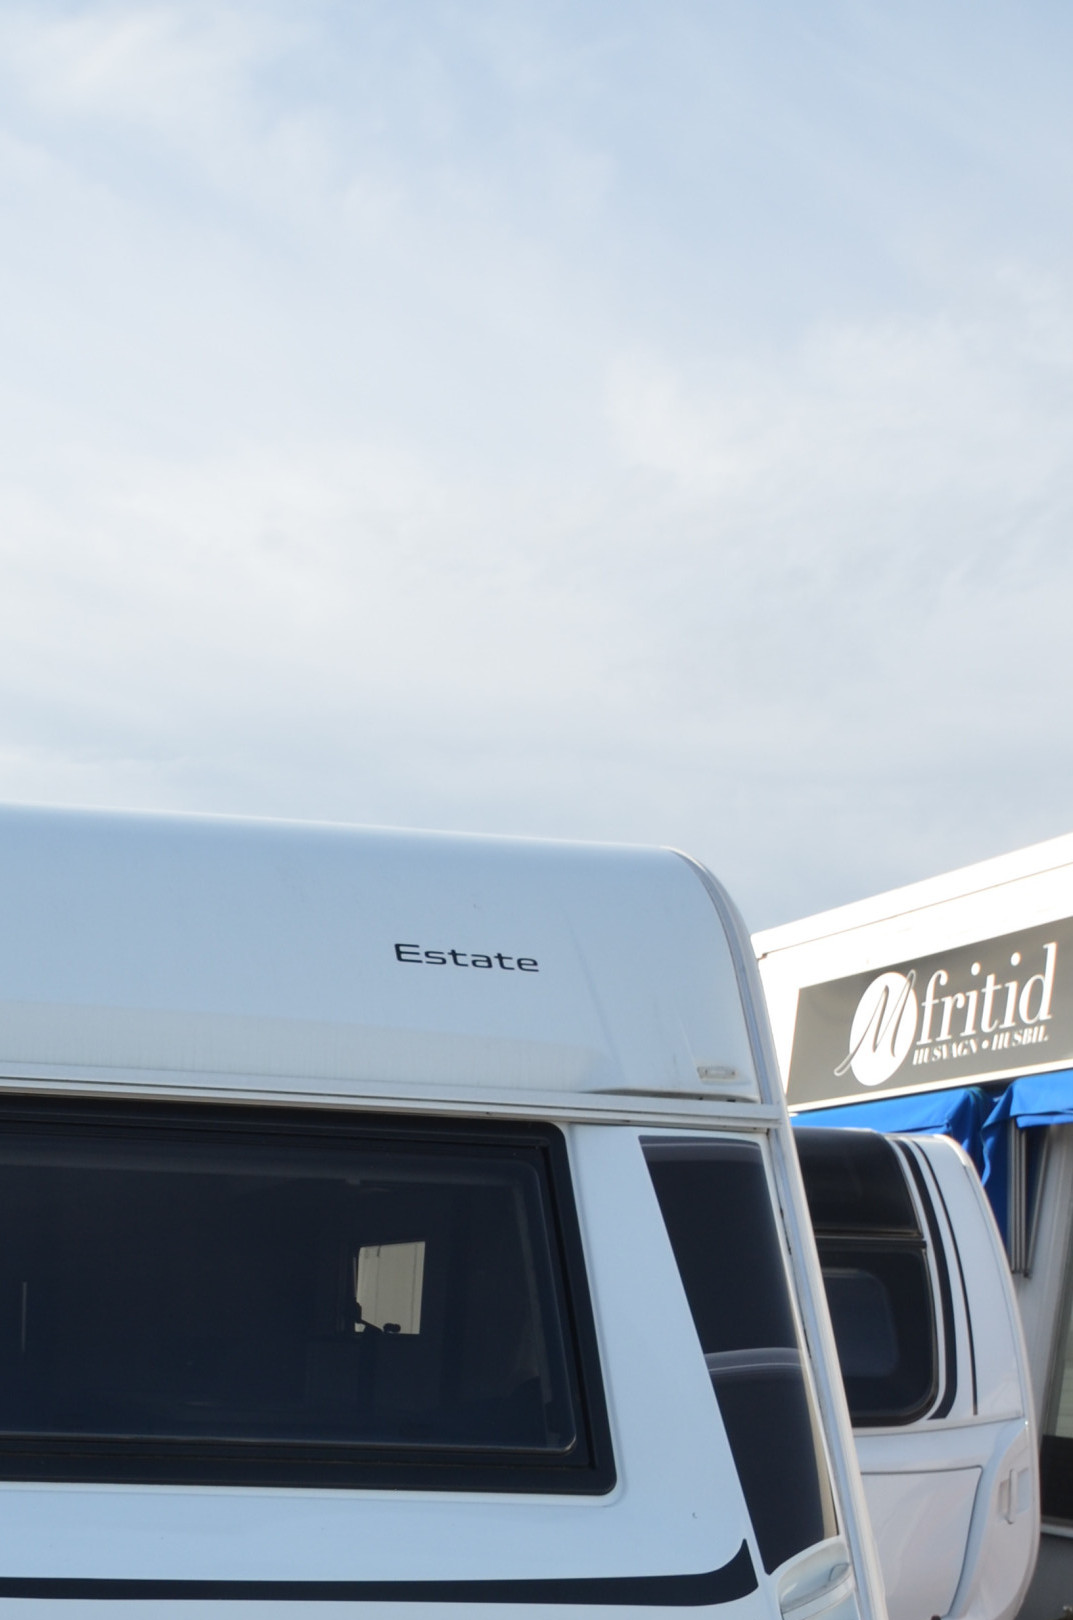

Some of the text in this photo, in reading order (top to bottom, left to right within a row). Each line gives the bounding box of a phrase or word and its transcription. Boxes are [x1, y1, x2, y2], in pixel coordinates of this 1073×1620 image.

[394, 943, 540, 972] Estate
[916, 941, 1058, 1046] fritid
[991, 1025, 1049, 1051] HUSBIL
